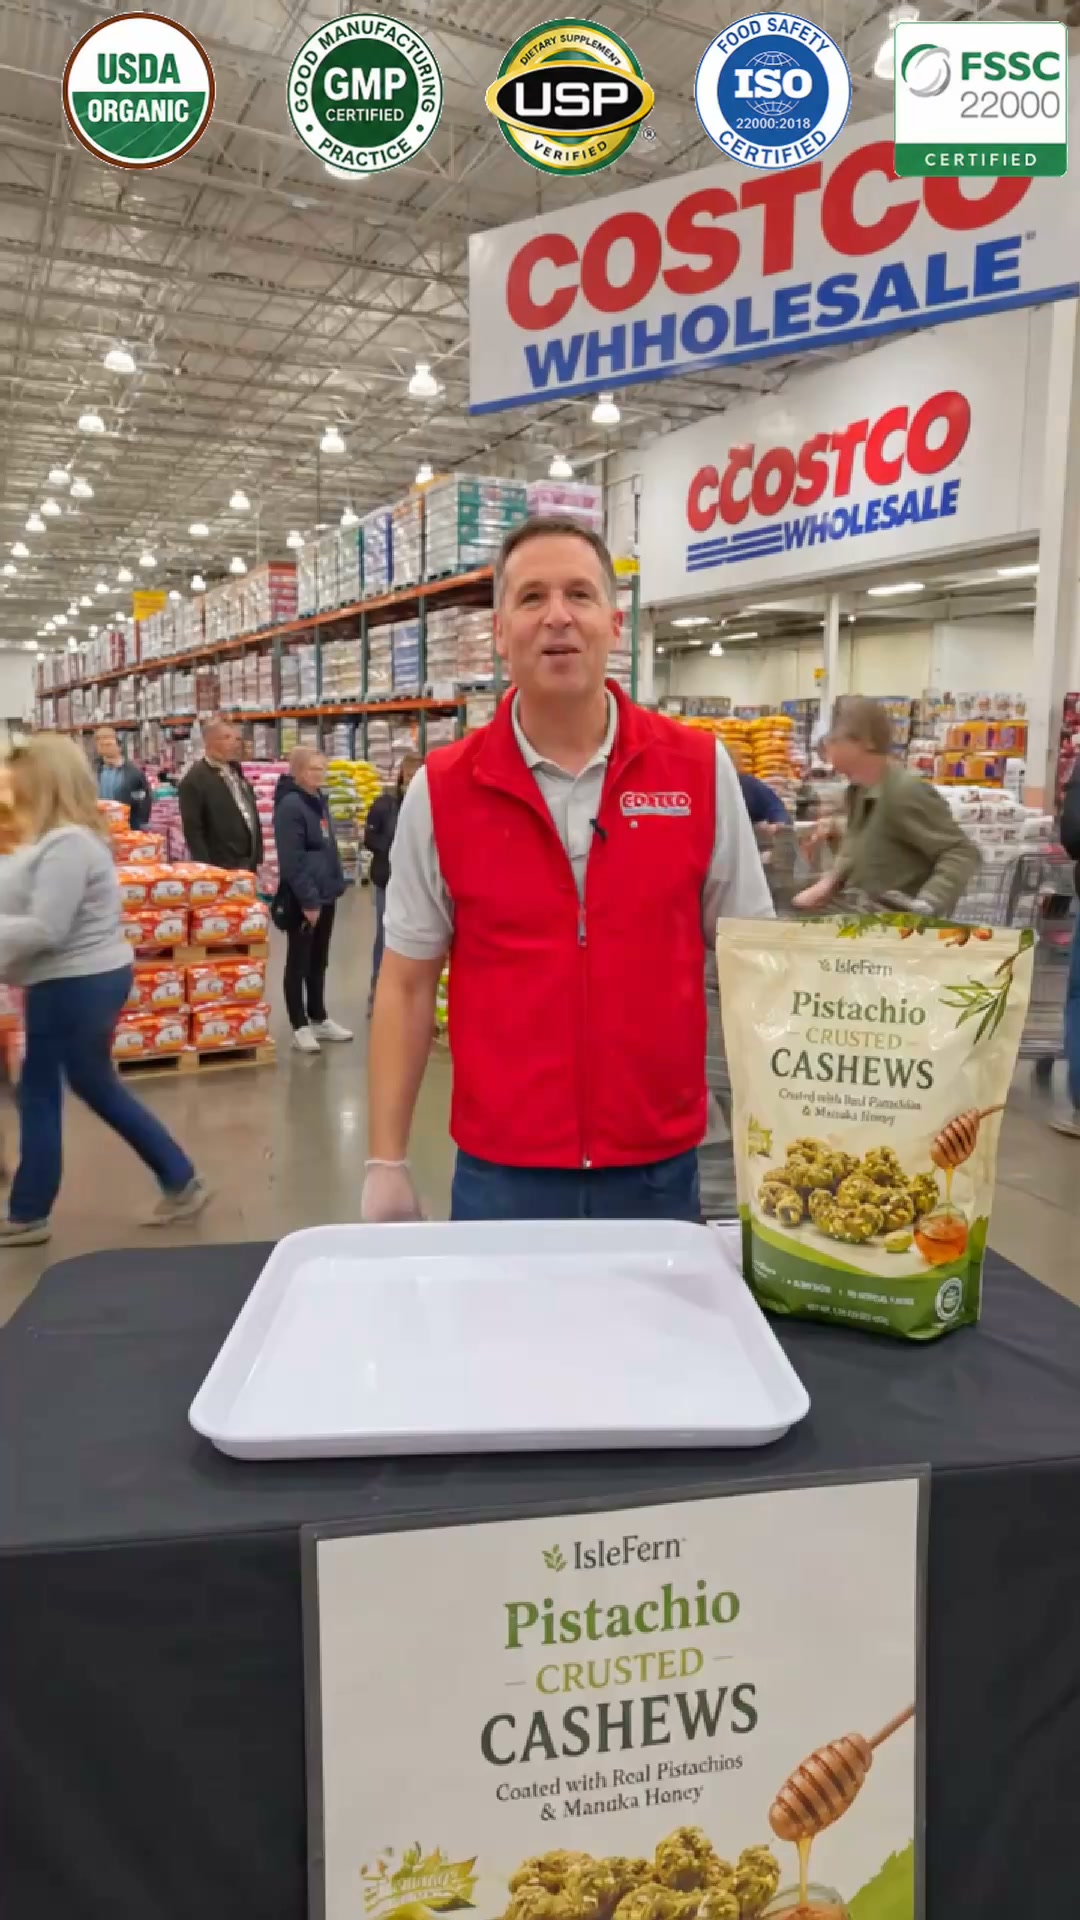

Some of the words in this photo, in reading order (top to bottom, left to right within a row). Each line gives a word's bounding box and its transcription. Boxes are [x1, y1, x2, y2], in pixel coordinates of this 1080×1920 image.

[524, 235, 1023, 388] WHHOLESALE
[784, 478, 961, 551] WHOLESALE
[790, 990, 926, 1026] Pistachio
[806, 1027, 903, 1050] CRUSTED
[771, 1047, 935, 1089] CASHEWS
[573, 1534, 681, 1570] IsleFern
[504, 1579, 741, 1650] Pistachio
[535, 1647, 704, 1695] CRUSTED
[480, 1682, 759, 1766] CASHEWS
[496, 1777, 561, 1802] Coated
[565, 1771, 608, 1793] with
[612, 1764, 651, 1788] Real
[656, 1754, 744, 1781] Pistachios
[540, 1802, 557, 1821] &
